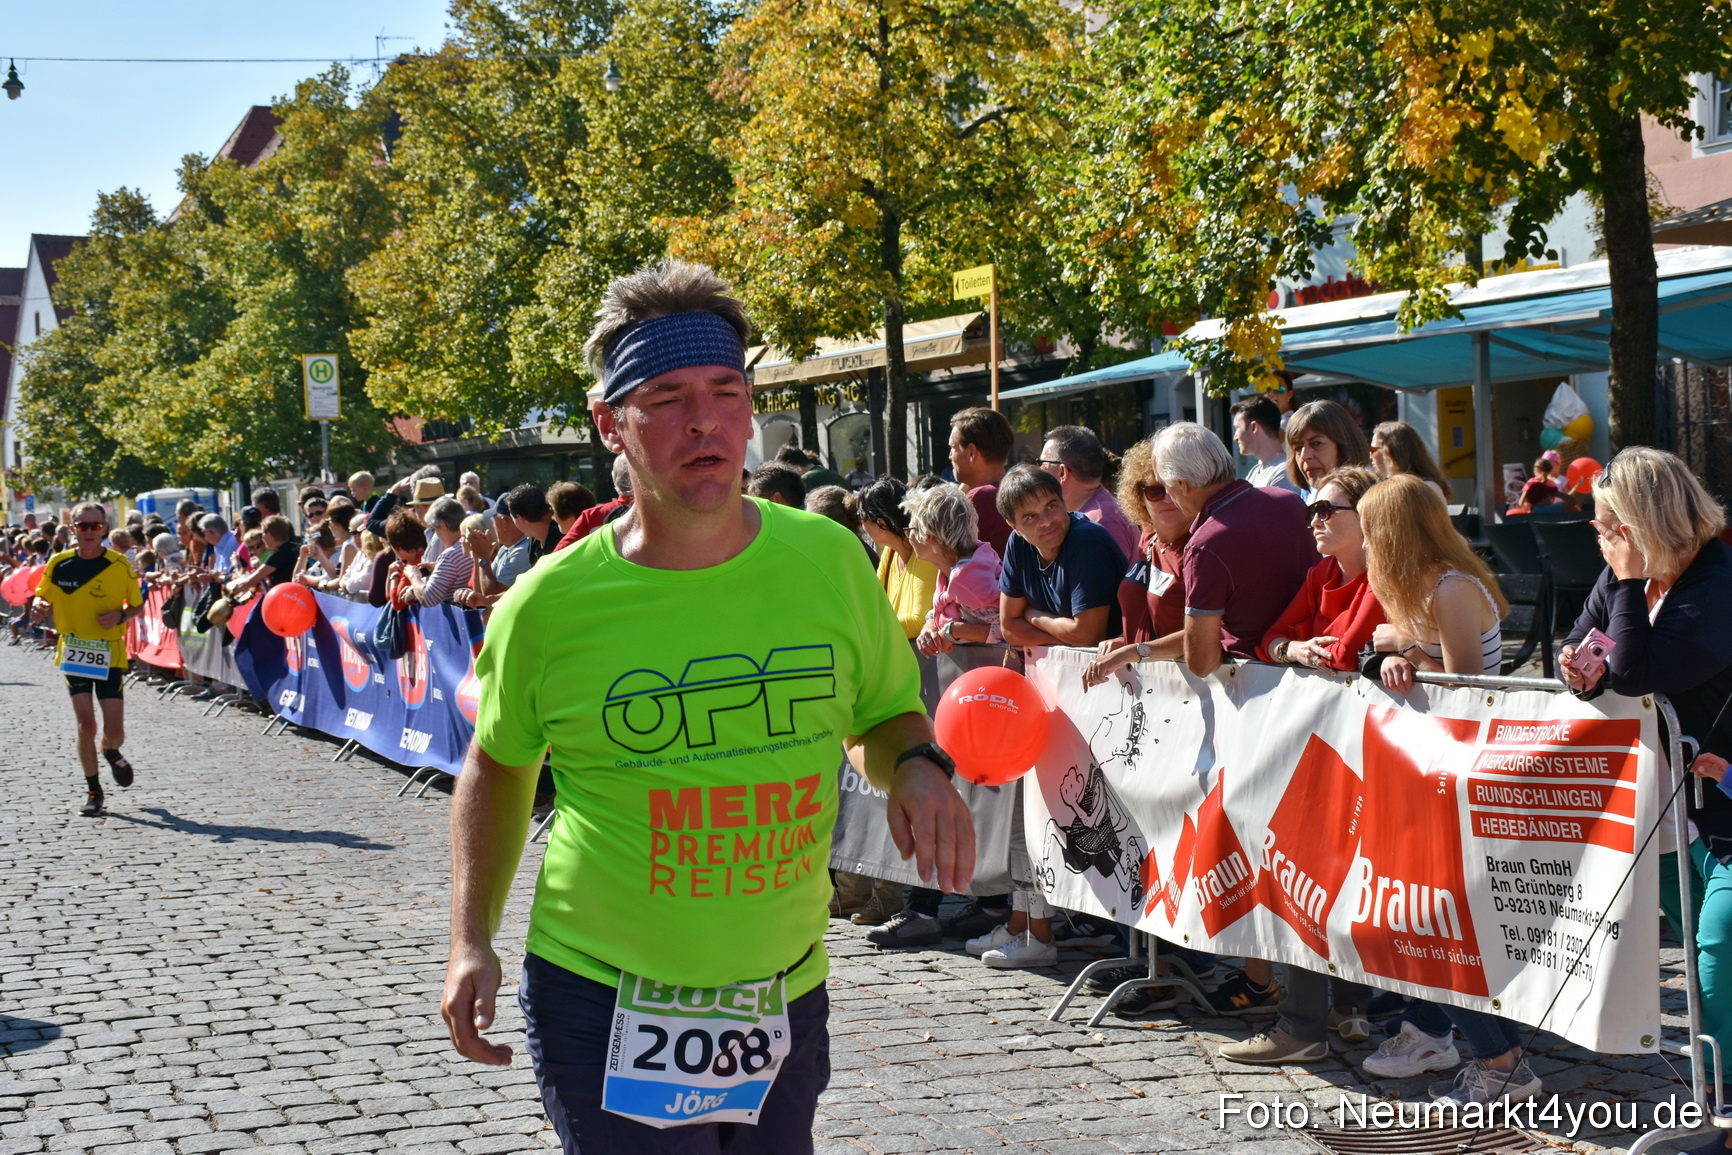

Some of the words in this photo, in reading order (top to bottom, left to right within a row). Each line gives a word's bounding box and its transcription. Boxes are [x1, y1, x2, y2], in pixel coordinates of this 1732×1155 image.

[961, 275, 991, 290] Toiletten
[315, 364, 328, 378] H
[67, 649, 105, 666] 2798
[1495, 724, 1572, 742] BINDESTRICKE
[615, 758, 667, 769] Gebäude-
[670, 755, 690, 766] und
[693, 737, 812, 762] Automatisierungstechnik
[1480, 754, 1610, 775] VERZURRSYSTEME
[648, 772, 822, 831] MERZ
[1476, 784, 1603, 808] RUNDSCHLINGEN
[1480, 817, 1583, 839] HEBEBÄNDER
[650, 820, 817, 866] PREMIUM
[649, 855, 811, 898] REISEN
[1261, 826, 1328, 925] Braun
[1486, 855, 1526, 874] Braun
[1530, 859, 1573, 877] GmbH
[1192, 851, 1250, 911] Braun
[1491, 876, 1512, 893] Am
[1515, 878, 1574, 903] Grünberg
[1577, 884, 1583, 900] 8
[1219, 894, 1238, 910] Sicher
[1238, 888, 1246, 899] ist
[1283, 894, 1299, 921] Sicher
[1299, 913, 1308, 928] ist
[1351, 856, 1463, 941] Braun
[1493, 896, 1547, 916] D-92318
[1500, 924, 1524, 942] Tel.
[1527, 927, 1557, 947] 09181
[1394, 939, 1428, 960] Sicher
[1430, 945, 1446, 961] ist
[1449, 948, 1482, 967] sicher
[1505, 944, 1528, 962] Fax
[1530, 947, 1557, 970] 09181
[632, 1024, 773, 1078] 2088
[665, 1090, 729, 1115] JÖRG
